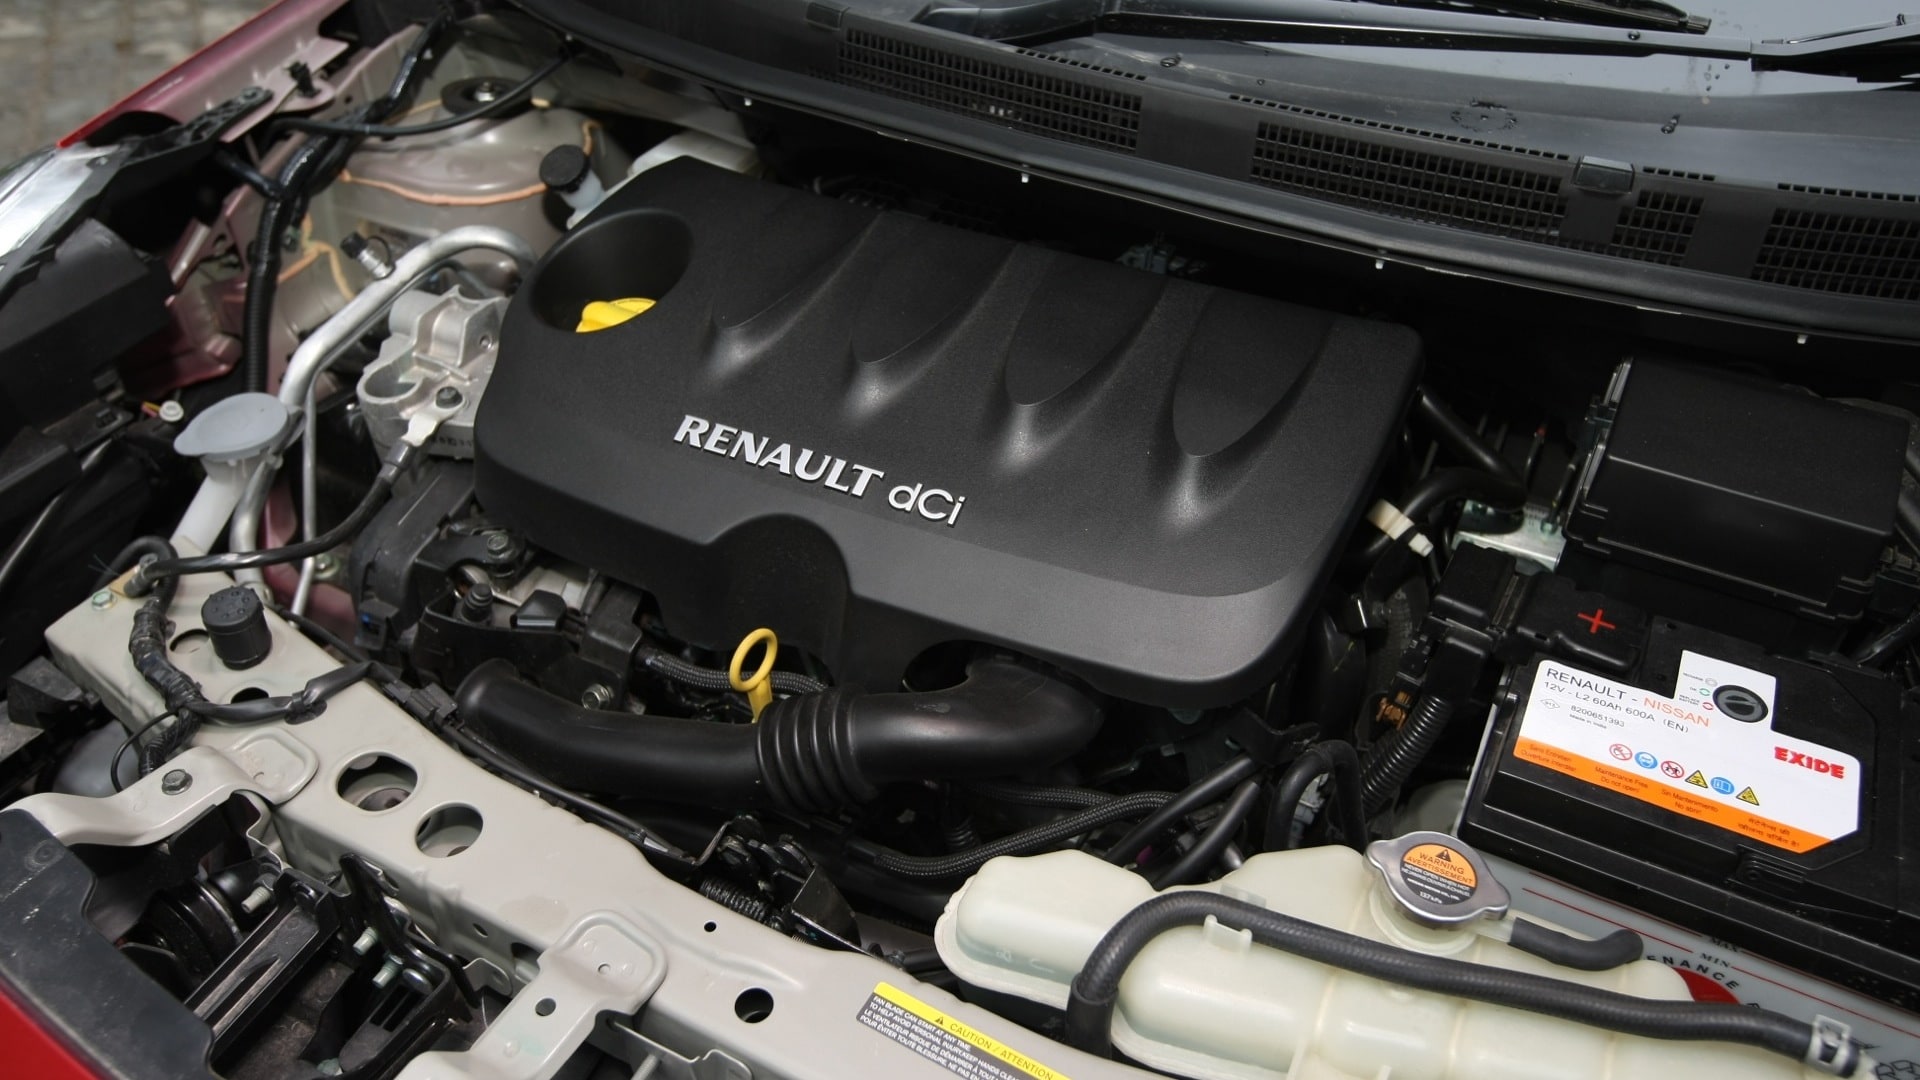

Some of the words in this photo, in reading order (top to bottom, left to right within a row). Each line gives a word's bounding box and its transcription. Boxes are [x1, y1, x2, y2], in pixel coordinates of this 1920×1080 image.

[673, 414, 885, 497] RENAULT
[888, 483, 966, 526] dCi
[1544, 681, 1566, 693] 12V
[1576, 693, 1590, 702] L2
[1592, 697, 1622, 712] 60Ah
[1625, 707, 1655, 722] 600A
[1663, 719, 1689, 733] (EN)
[1546, 668, 1627, 700] RENAULT
[1644, 697, 1711, 728] NISSAN
[1571, 705, 1625, 727] 8200651393
[1595, 765, 1633, 784] Maintenance
[1634, 778, 1648, 789] Free
[1773, 745, 1845, 779] EXIDE
[1601, 776, 1610, 784] Do
[1611, 780, 1621, 788] not
[1661, 788, 1671, 796] Sin
[1672, 792, 1719, 812] Mantenimiento
[1675, 801, 1684, 809] No
[1407, 856, 1473, 884] AVERTISSEMENT
[1420, 852, 1464, 875] WARNING
[1702, 952, 1730, 968] MIN
[1710, 937, 1738, 952] MAX
[864, 1008, 873, 1017] LE
[872, 1012, 910, 1037] VENTILATEUR
[909, 1032, 932, 1049] RISQUE
[930, 1044, 941, 1054] DE
[873, 995, 886, 1007] FAN
[885, 1001, 905, 1016] BLADE
[904, 1011, 918, 1023] CAN
[917, 1018, 936, 1033] START
[935, 1026, 944, 1036] AT
[943, 1031, 958, 1043] ANY
[860, 1014, 878, 1028] POUR
[877, 1023, 898, 1039] ÉVITER
[897, 1034, 917, 1049] TOUTE
[948, 1061, 958, 1072] NE
[957, 1066, 971, 1078] PAS
[870, 1002, 878, 1010] TO
[878, 1006, 894, 1018] HELP
[893, 1014, 911, 1028] AVOID
[911, 1024, 941, 1045] PERSONAL
[978, 1059, 1000, 1075] HANDS
[950, 1023, 992, 1049] CAUTION
[1000, 1050, 1053, 1080] ATTENTION
